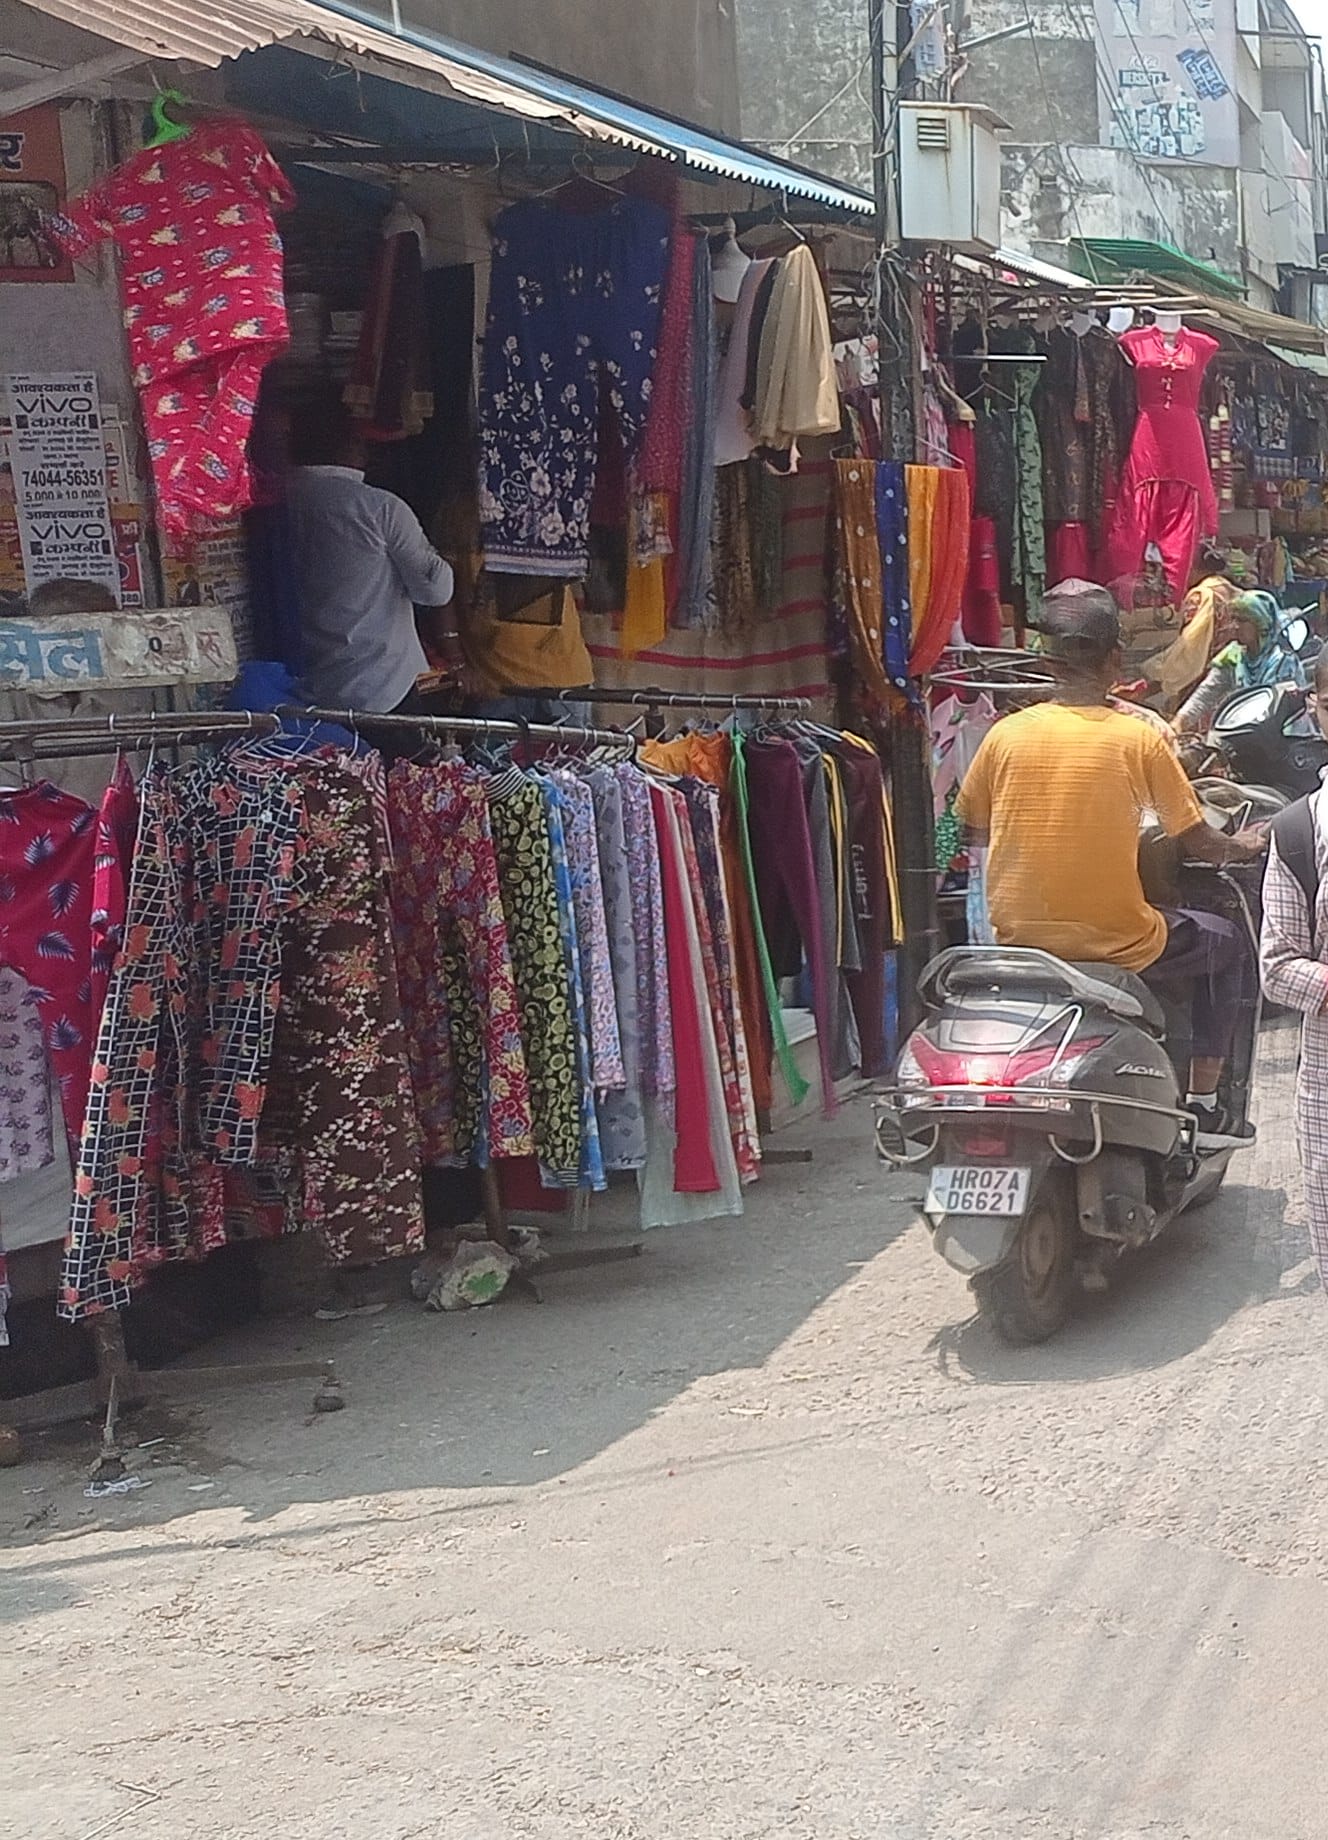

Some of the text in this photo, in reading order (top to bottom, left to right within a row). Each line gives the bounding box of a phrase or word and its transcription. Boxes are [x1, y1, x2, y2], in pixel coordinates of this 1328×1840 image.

[22, 469, 104, 487] 74044-56351
[951, 1169, 1019, 1190] HR07A
[947, 1191, 1015, 1211] D6621
